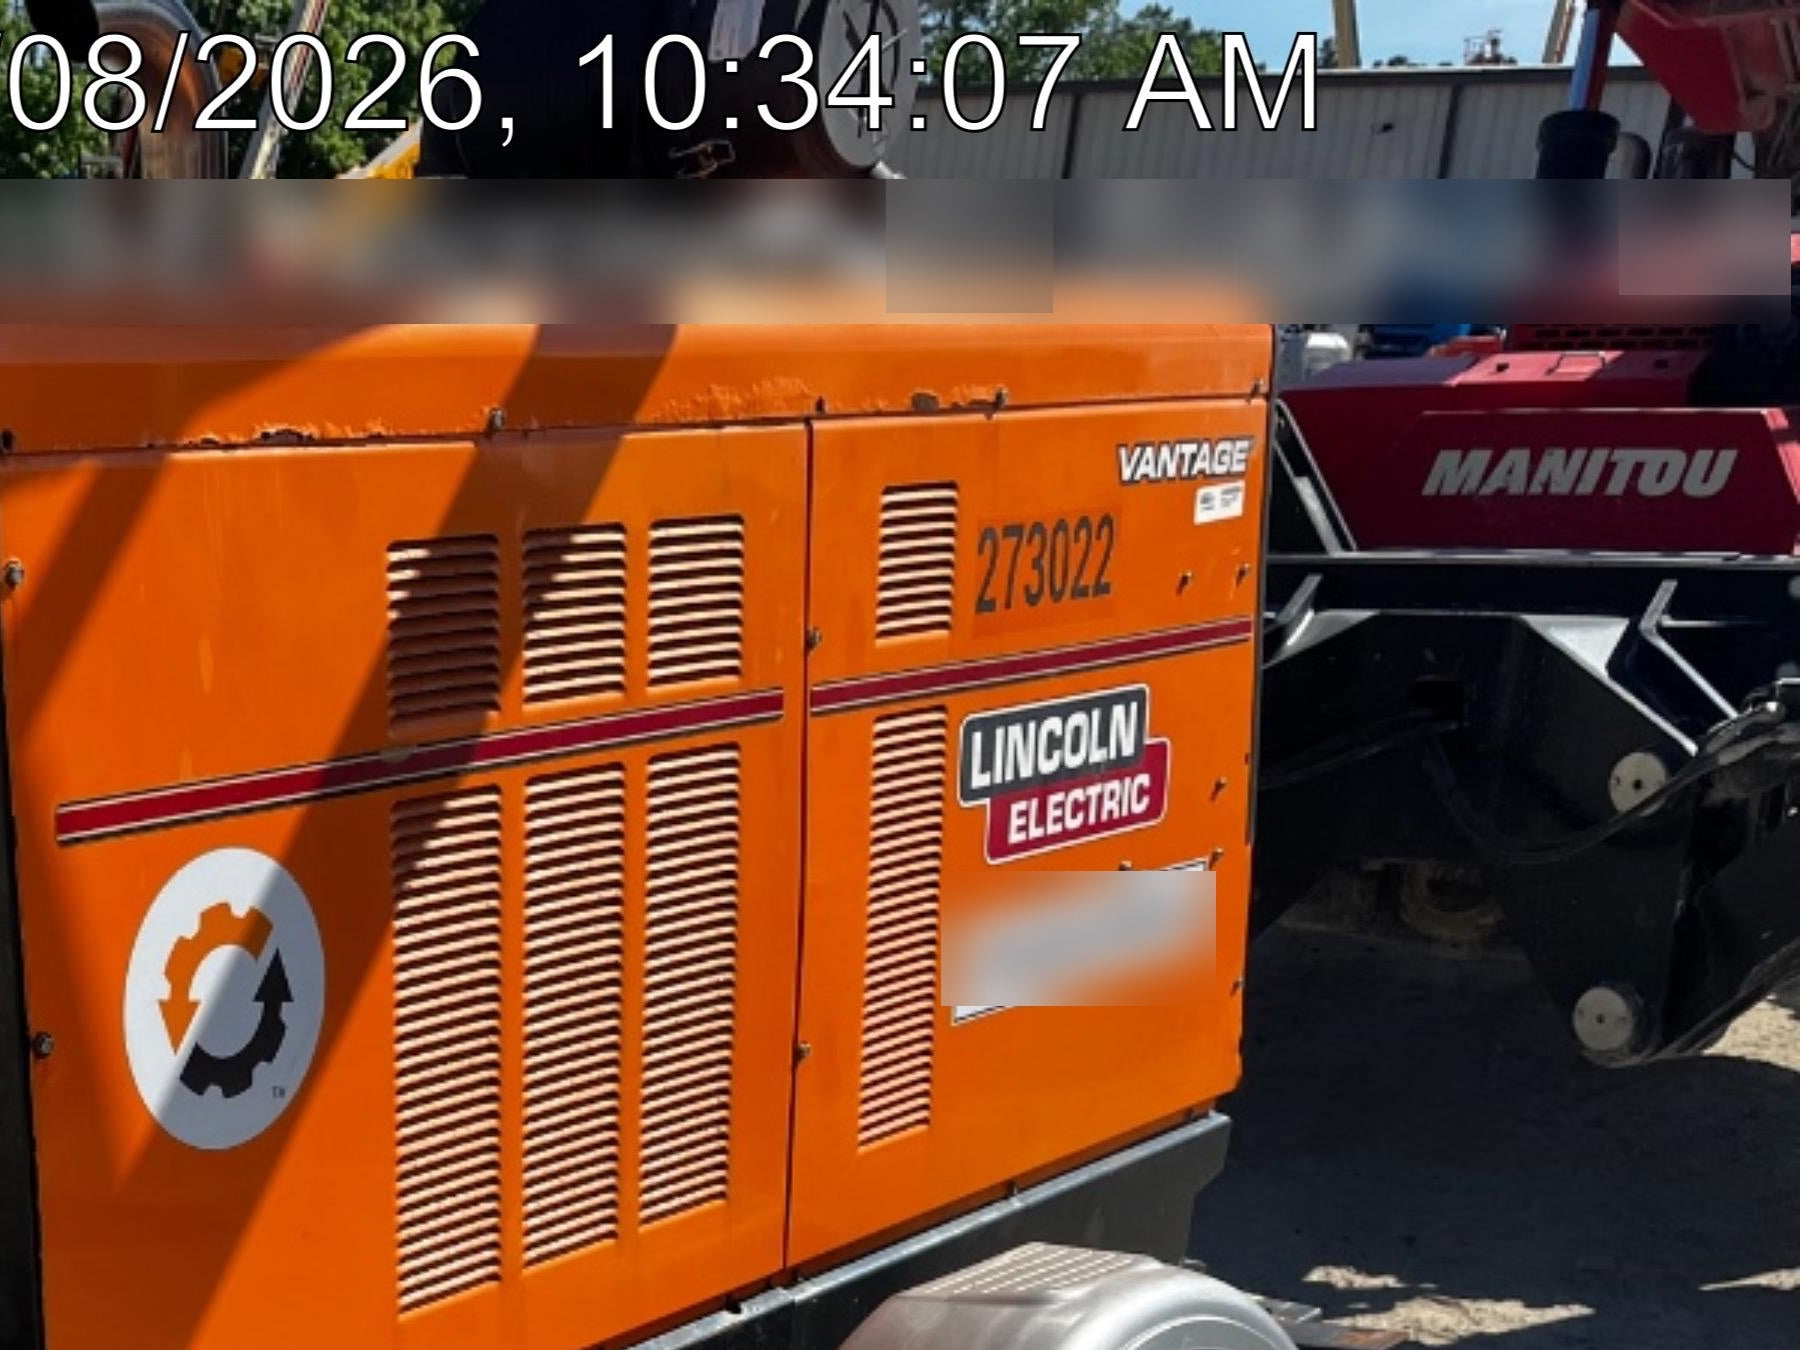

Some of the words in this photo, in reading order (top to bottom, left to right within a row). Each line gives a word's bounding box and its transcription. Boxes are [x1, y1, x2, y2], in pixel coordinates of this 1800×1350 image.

[1118, 438, 1252, 483] VANTAGE
[1421, 447, 1737, 499] MANITOU
[975, 514, 1115, 614] 273022
[970, 701, 1139, 790] LINCOLN
[1008, 773, 1151, 845] ELECTRIC
